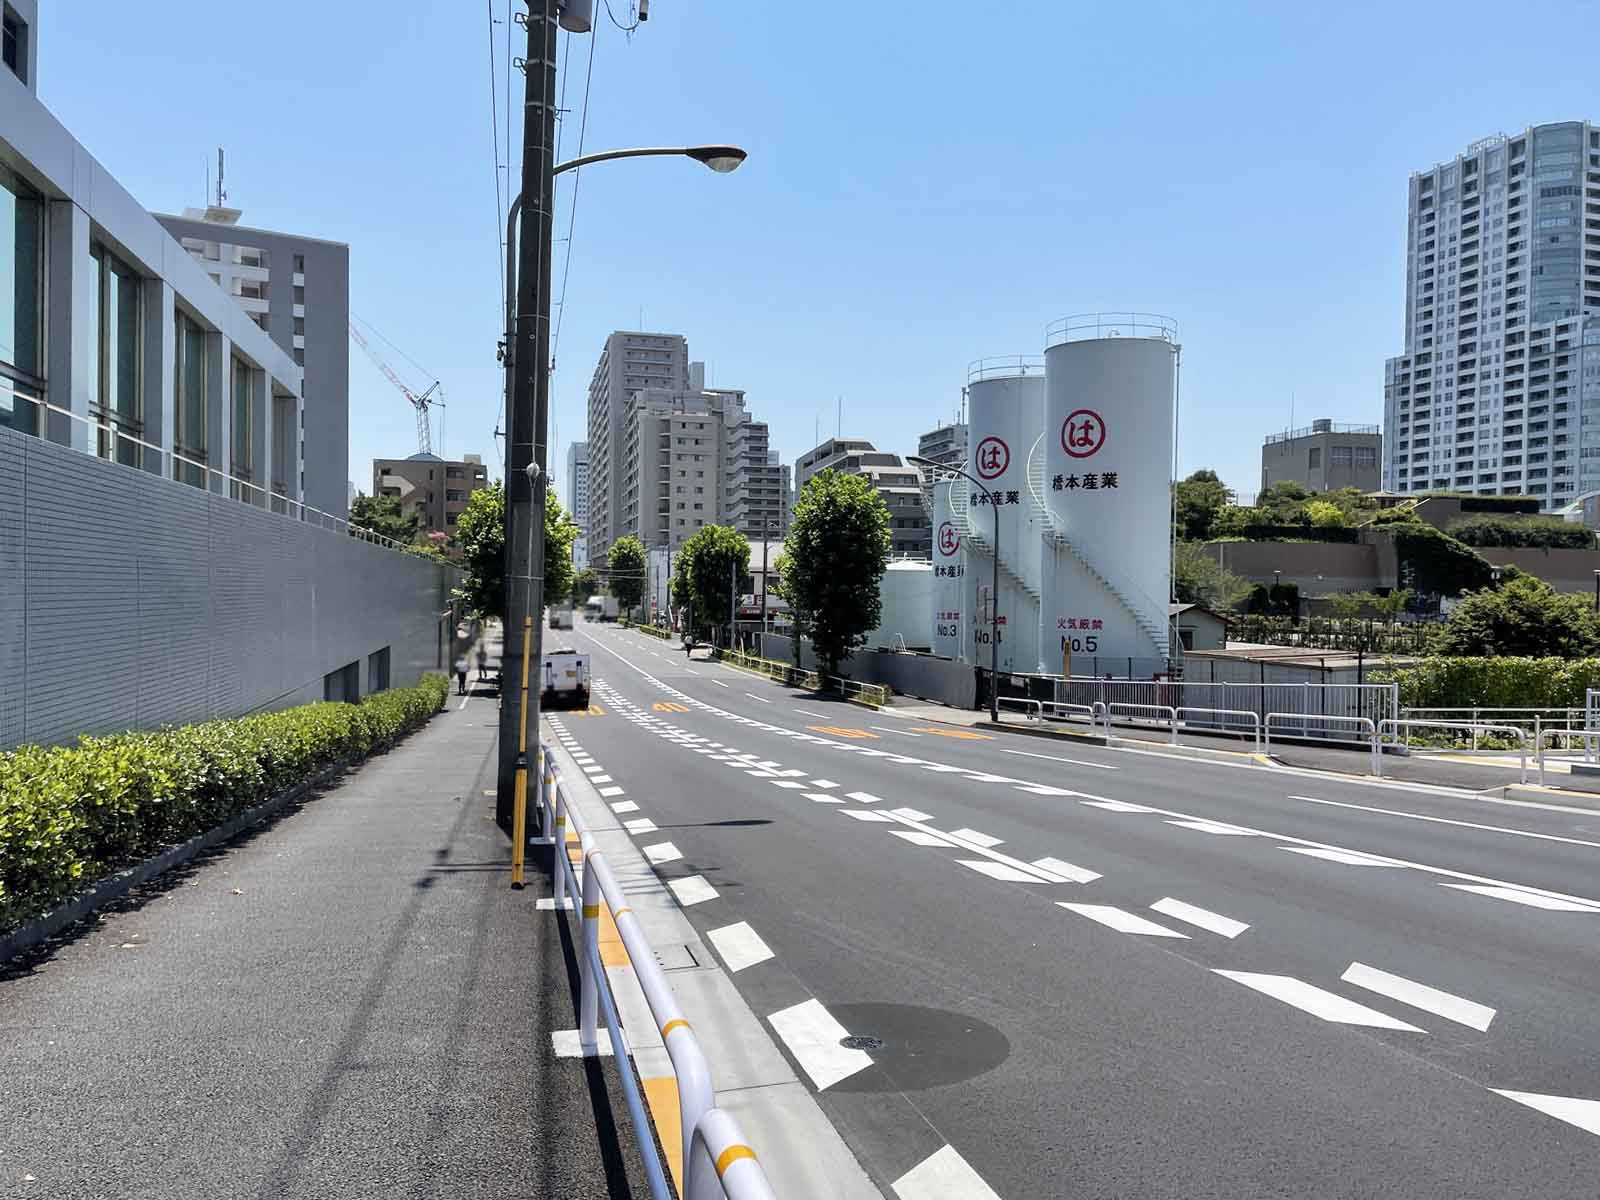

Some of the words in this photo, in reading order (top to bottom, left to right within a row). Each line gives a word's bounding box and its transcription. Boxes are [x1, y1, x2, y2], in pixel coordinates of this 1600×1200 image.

[1052, 472, 1119, 492] 橋本産業
[937, 624, 957, 637] No.3
[1061, 635, 1098, 652] No.5
